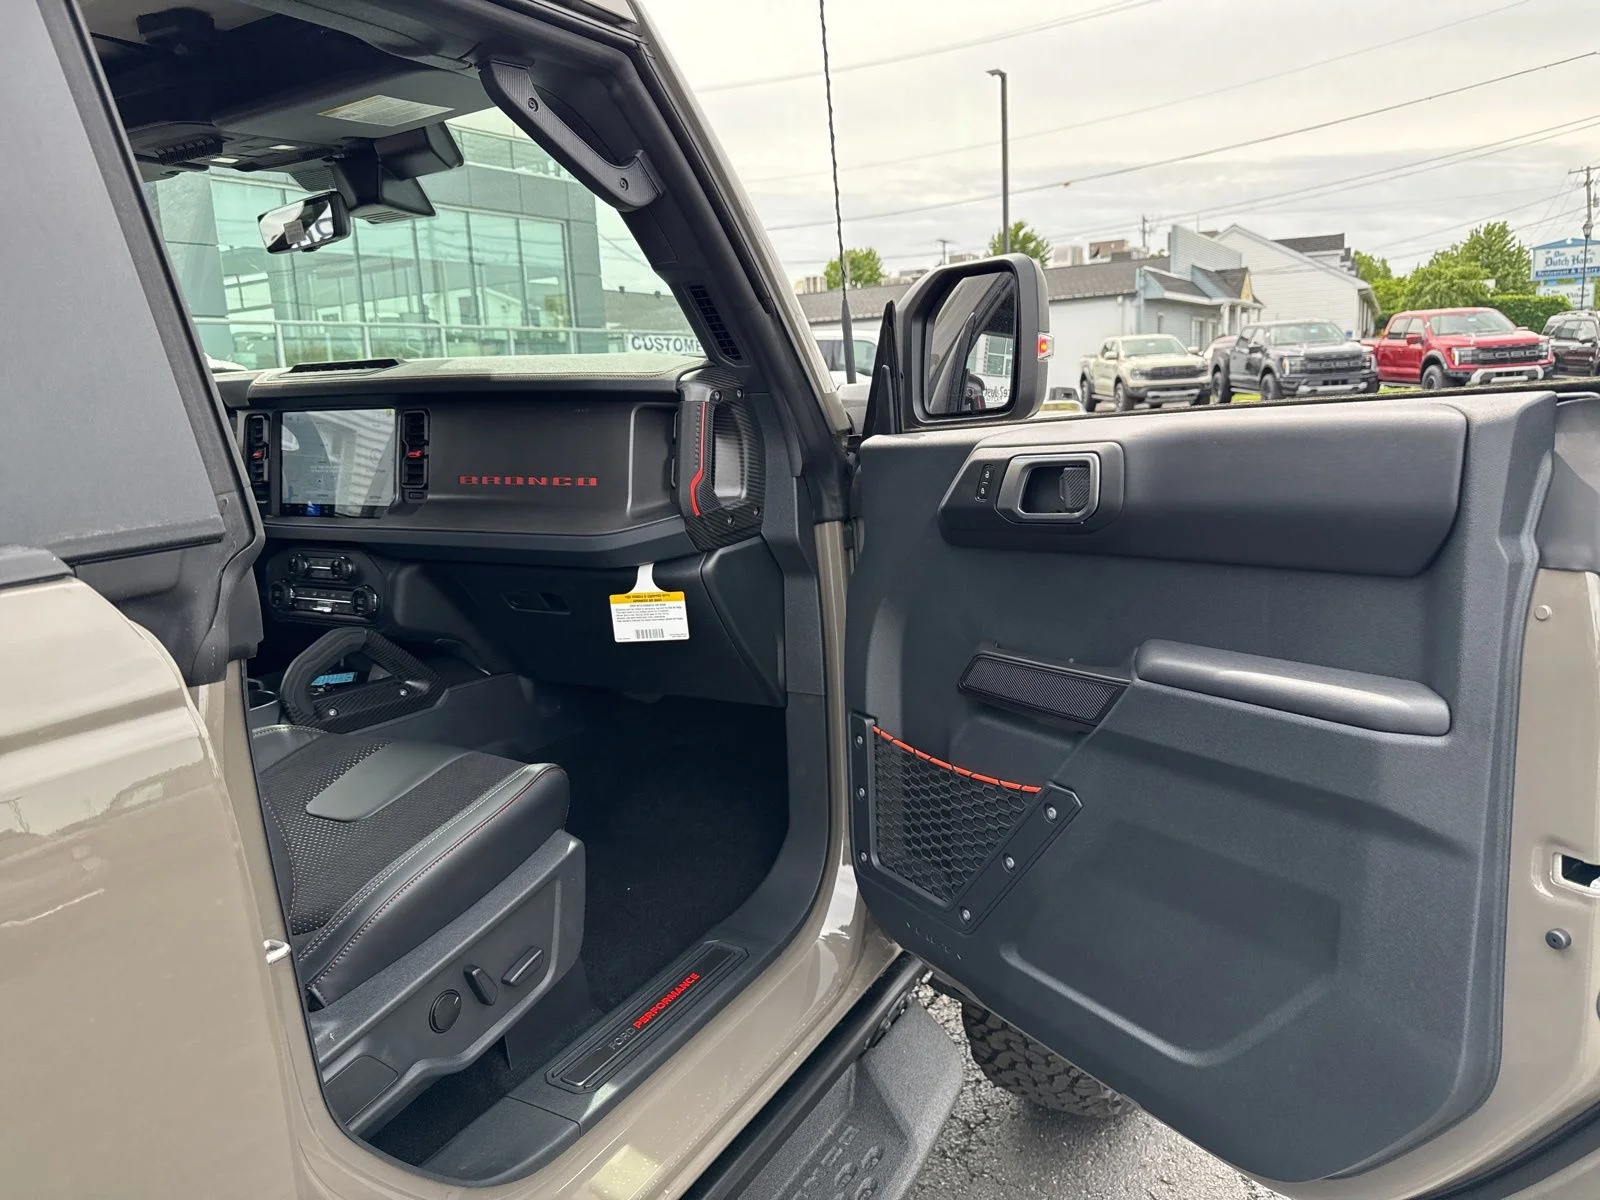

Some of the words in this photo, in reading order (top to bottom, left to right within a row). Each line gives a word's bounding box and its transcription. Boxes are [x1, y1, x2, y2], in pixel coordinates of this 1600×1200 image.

[459, 476, 597, 486] BRONCO
[608, 1027, 636, 1050] FORD
[633, 972, 700, 1029] PERFORMANCE
